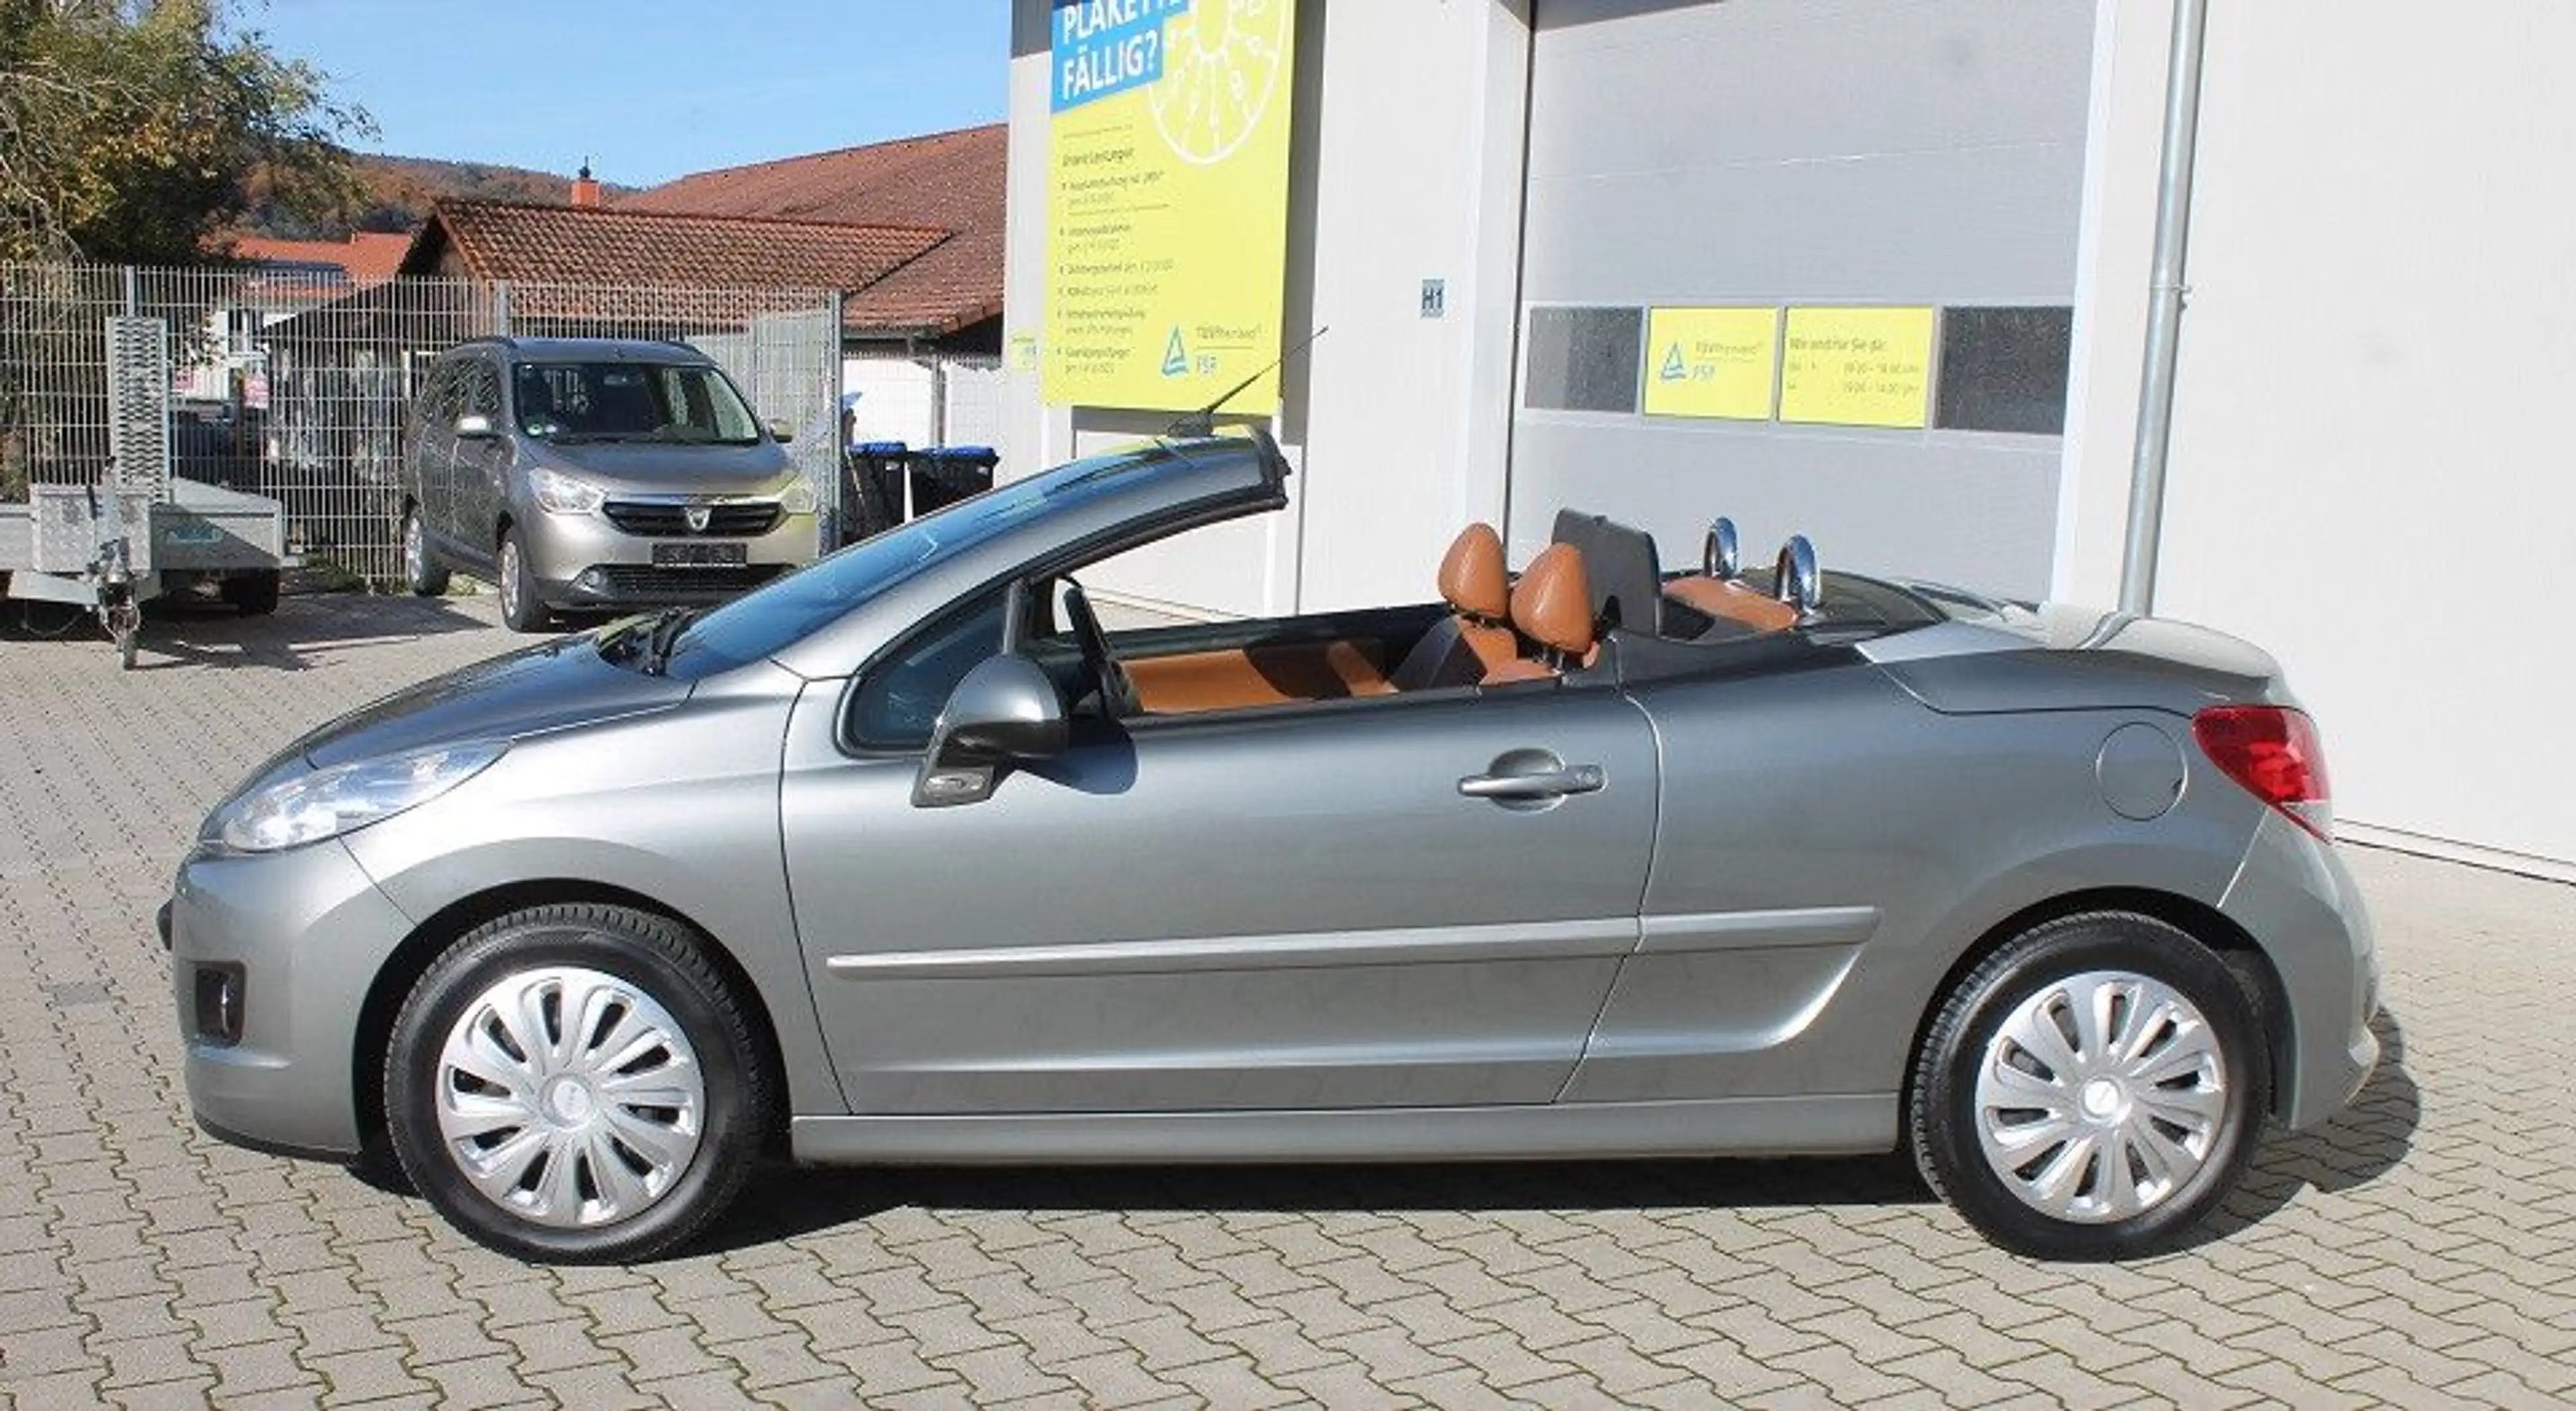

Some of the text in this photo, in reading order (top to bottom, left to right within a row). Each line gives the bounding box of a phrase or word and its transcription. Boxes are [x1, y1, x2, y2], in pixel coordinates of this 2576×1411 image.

[1063, 0, 1182, 44] PLAKE
[1063, 29, 1158, 100] FÄLLIG?
[1422, 287, 1443, 309] H1
